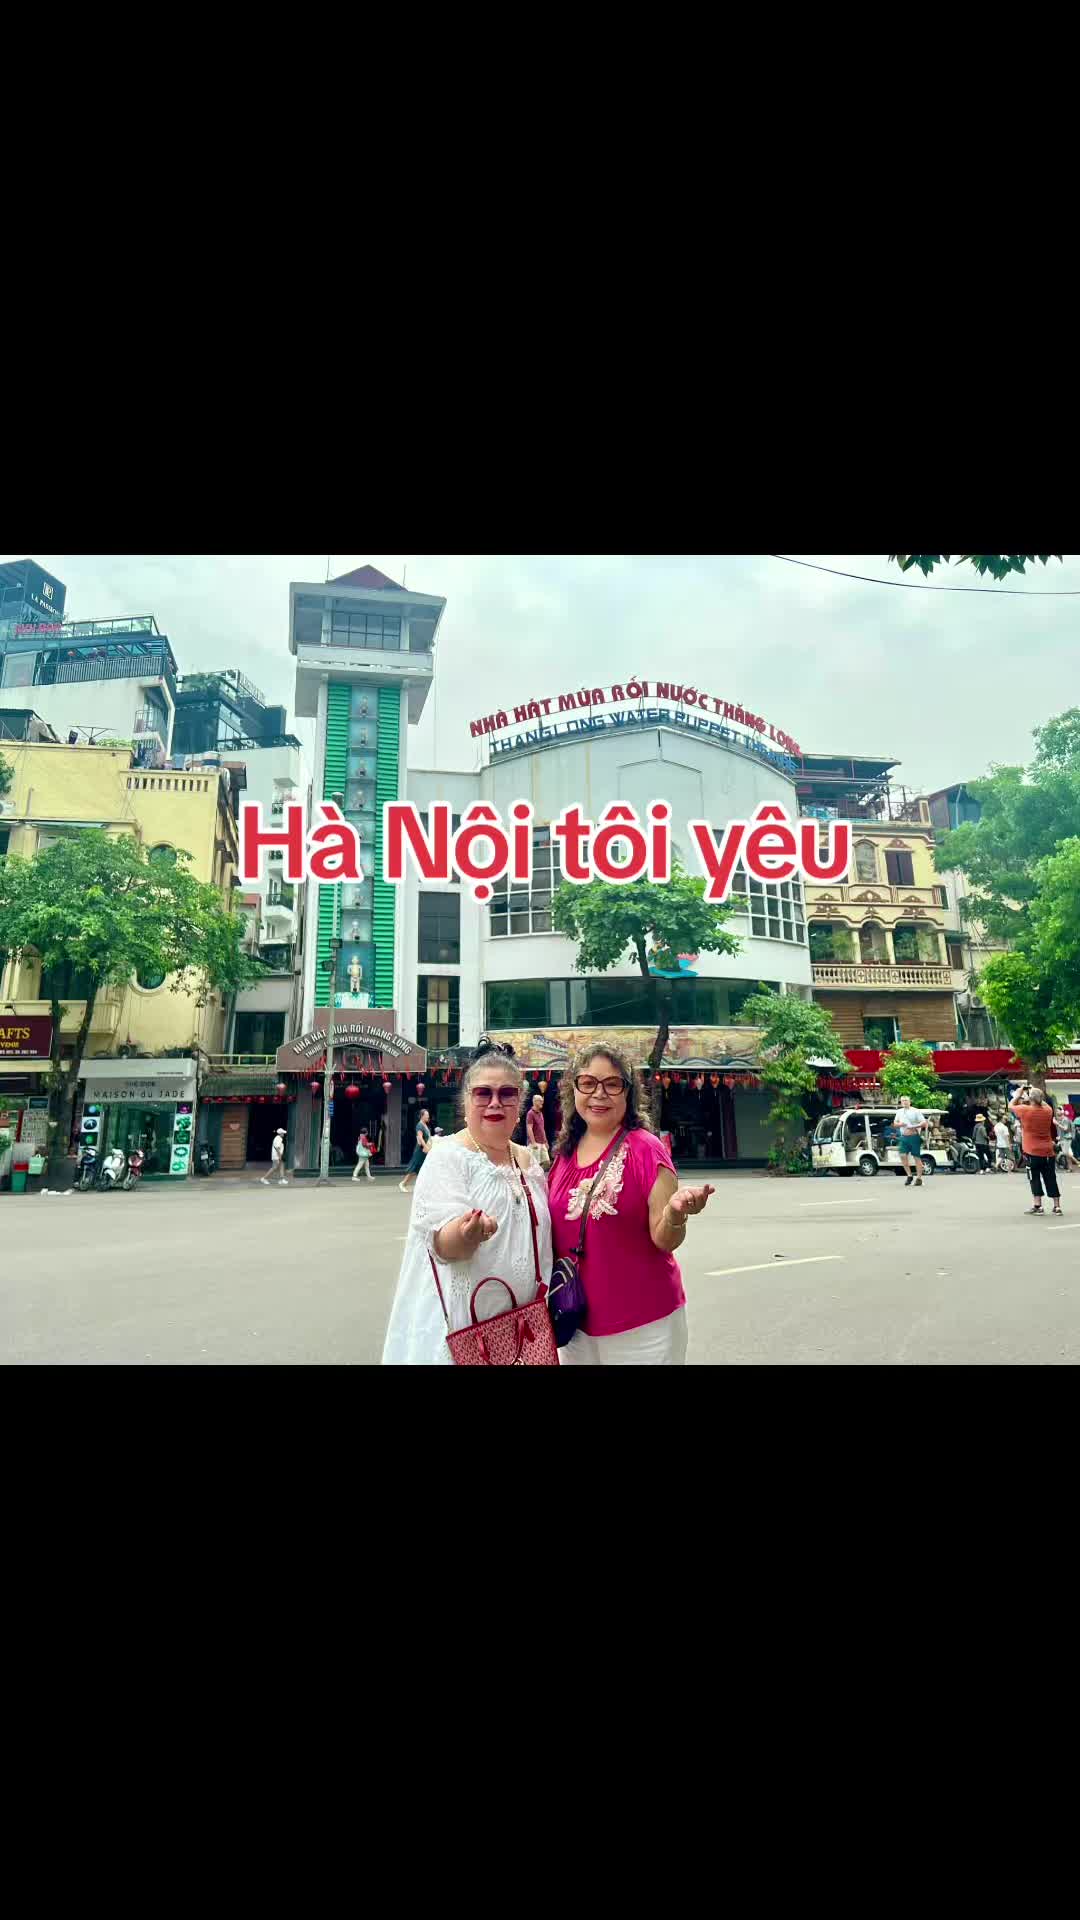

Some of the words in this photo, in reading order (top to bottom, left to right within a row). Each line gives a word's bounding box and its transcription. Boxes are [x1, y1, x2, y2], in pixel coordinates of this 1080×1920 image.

[469, 708, 509, 738] NHÀ
[513, 697, 552, 723] HÁT
[557, 687, 606, 713] MÚA
[611, 675, 649, 702] RỐI
[656, 681, 709, 711] NƯỚC
[712, 697, 767, 733] THĂNG
[769, 724, 803, 758] LONG
[608, 708, 671, 727] WATER
[674, 709, 739, 743] PUPPET
[339, 1035, 358, 1043] WATER
[358, 1036, 379, 1047] PUPPET
[391, 1035, 413, 1055] LONG
[93, 1090, 135, 1099] MAISON
[140, 1090, 153, 1098] du
[159, 1090, 185, 1098] JADE
